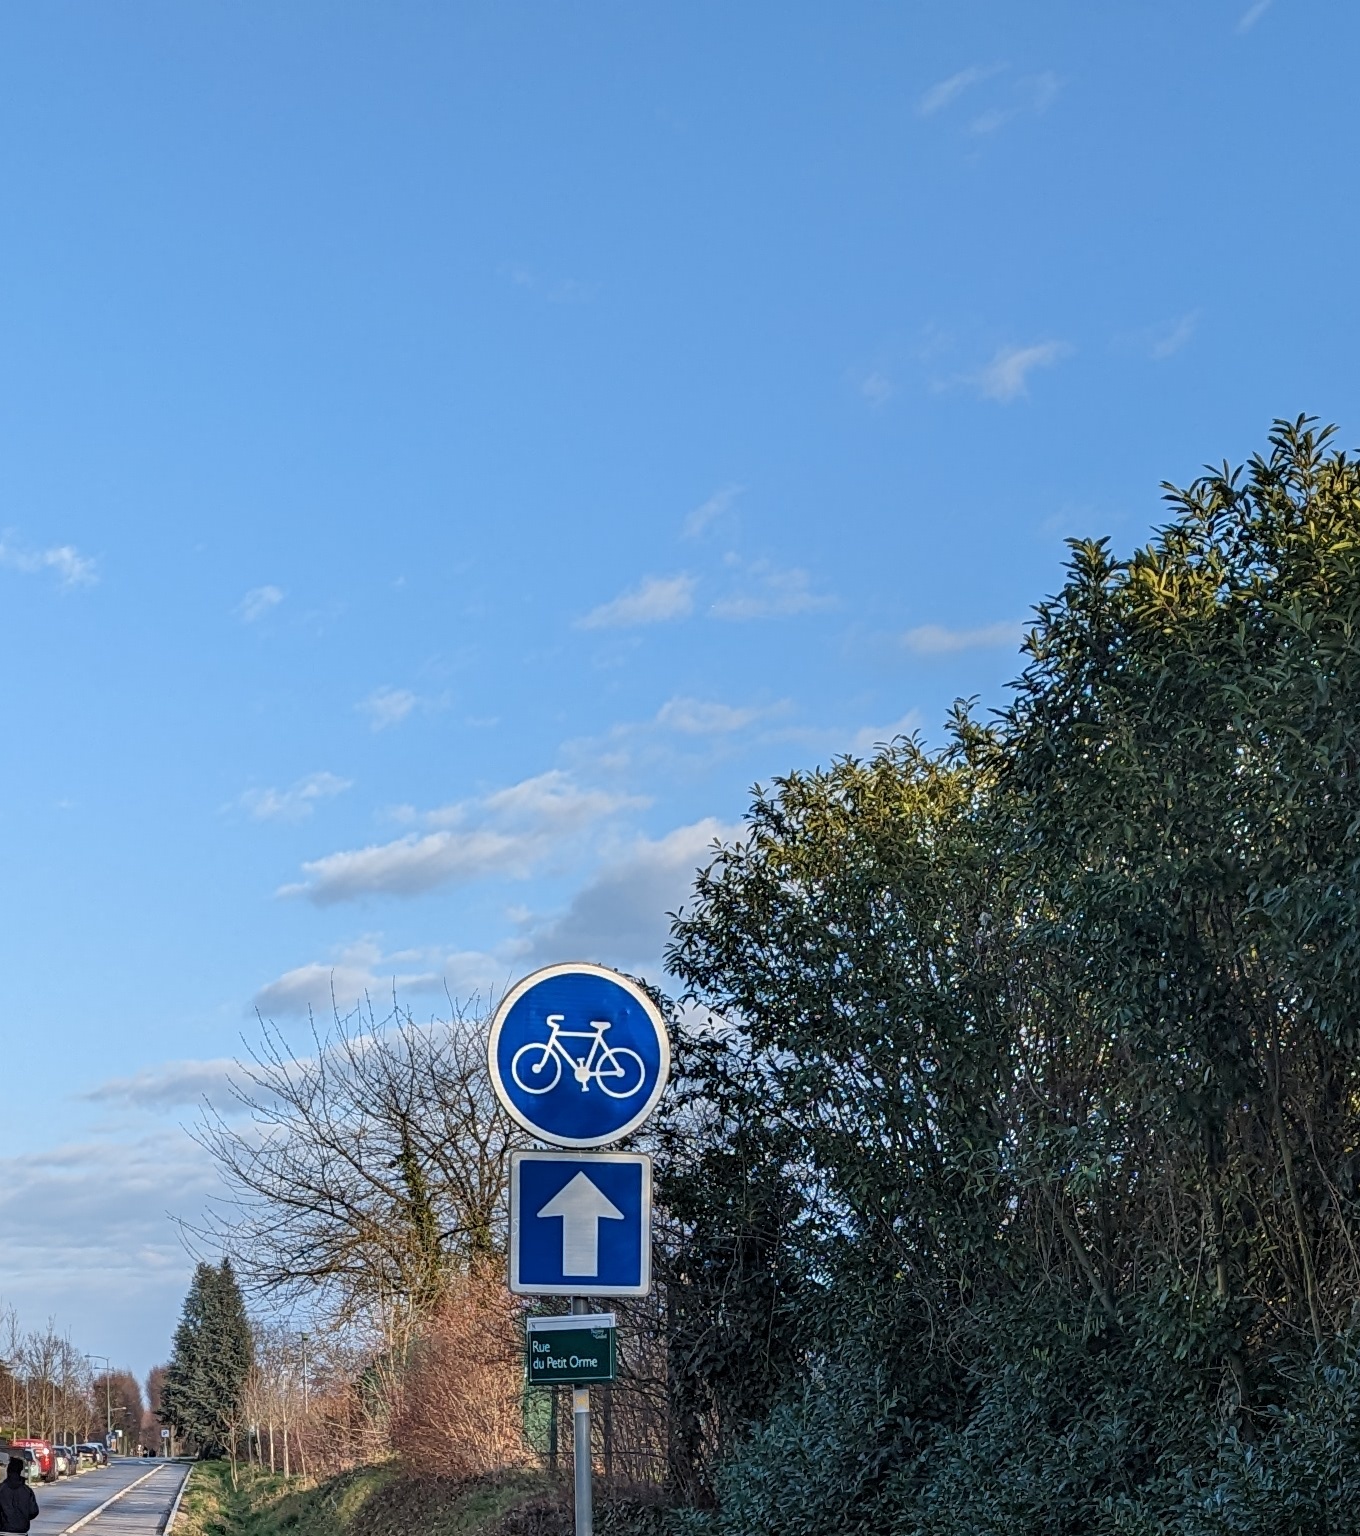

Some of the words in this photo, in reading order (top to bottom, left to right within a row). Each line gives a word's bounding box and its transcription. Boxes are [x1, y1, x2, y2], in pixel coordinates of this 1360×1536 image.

[532, 1340, 551, 1353] Rue
[532, 1356, 545, 1370] du
[546, 1356, 568, 1369] Petit
[569, 1355, 598, 1368] Orme
